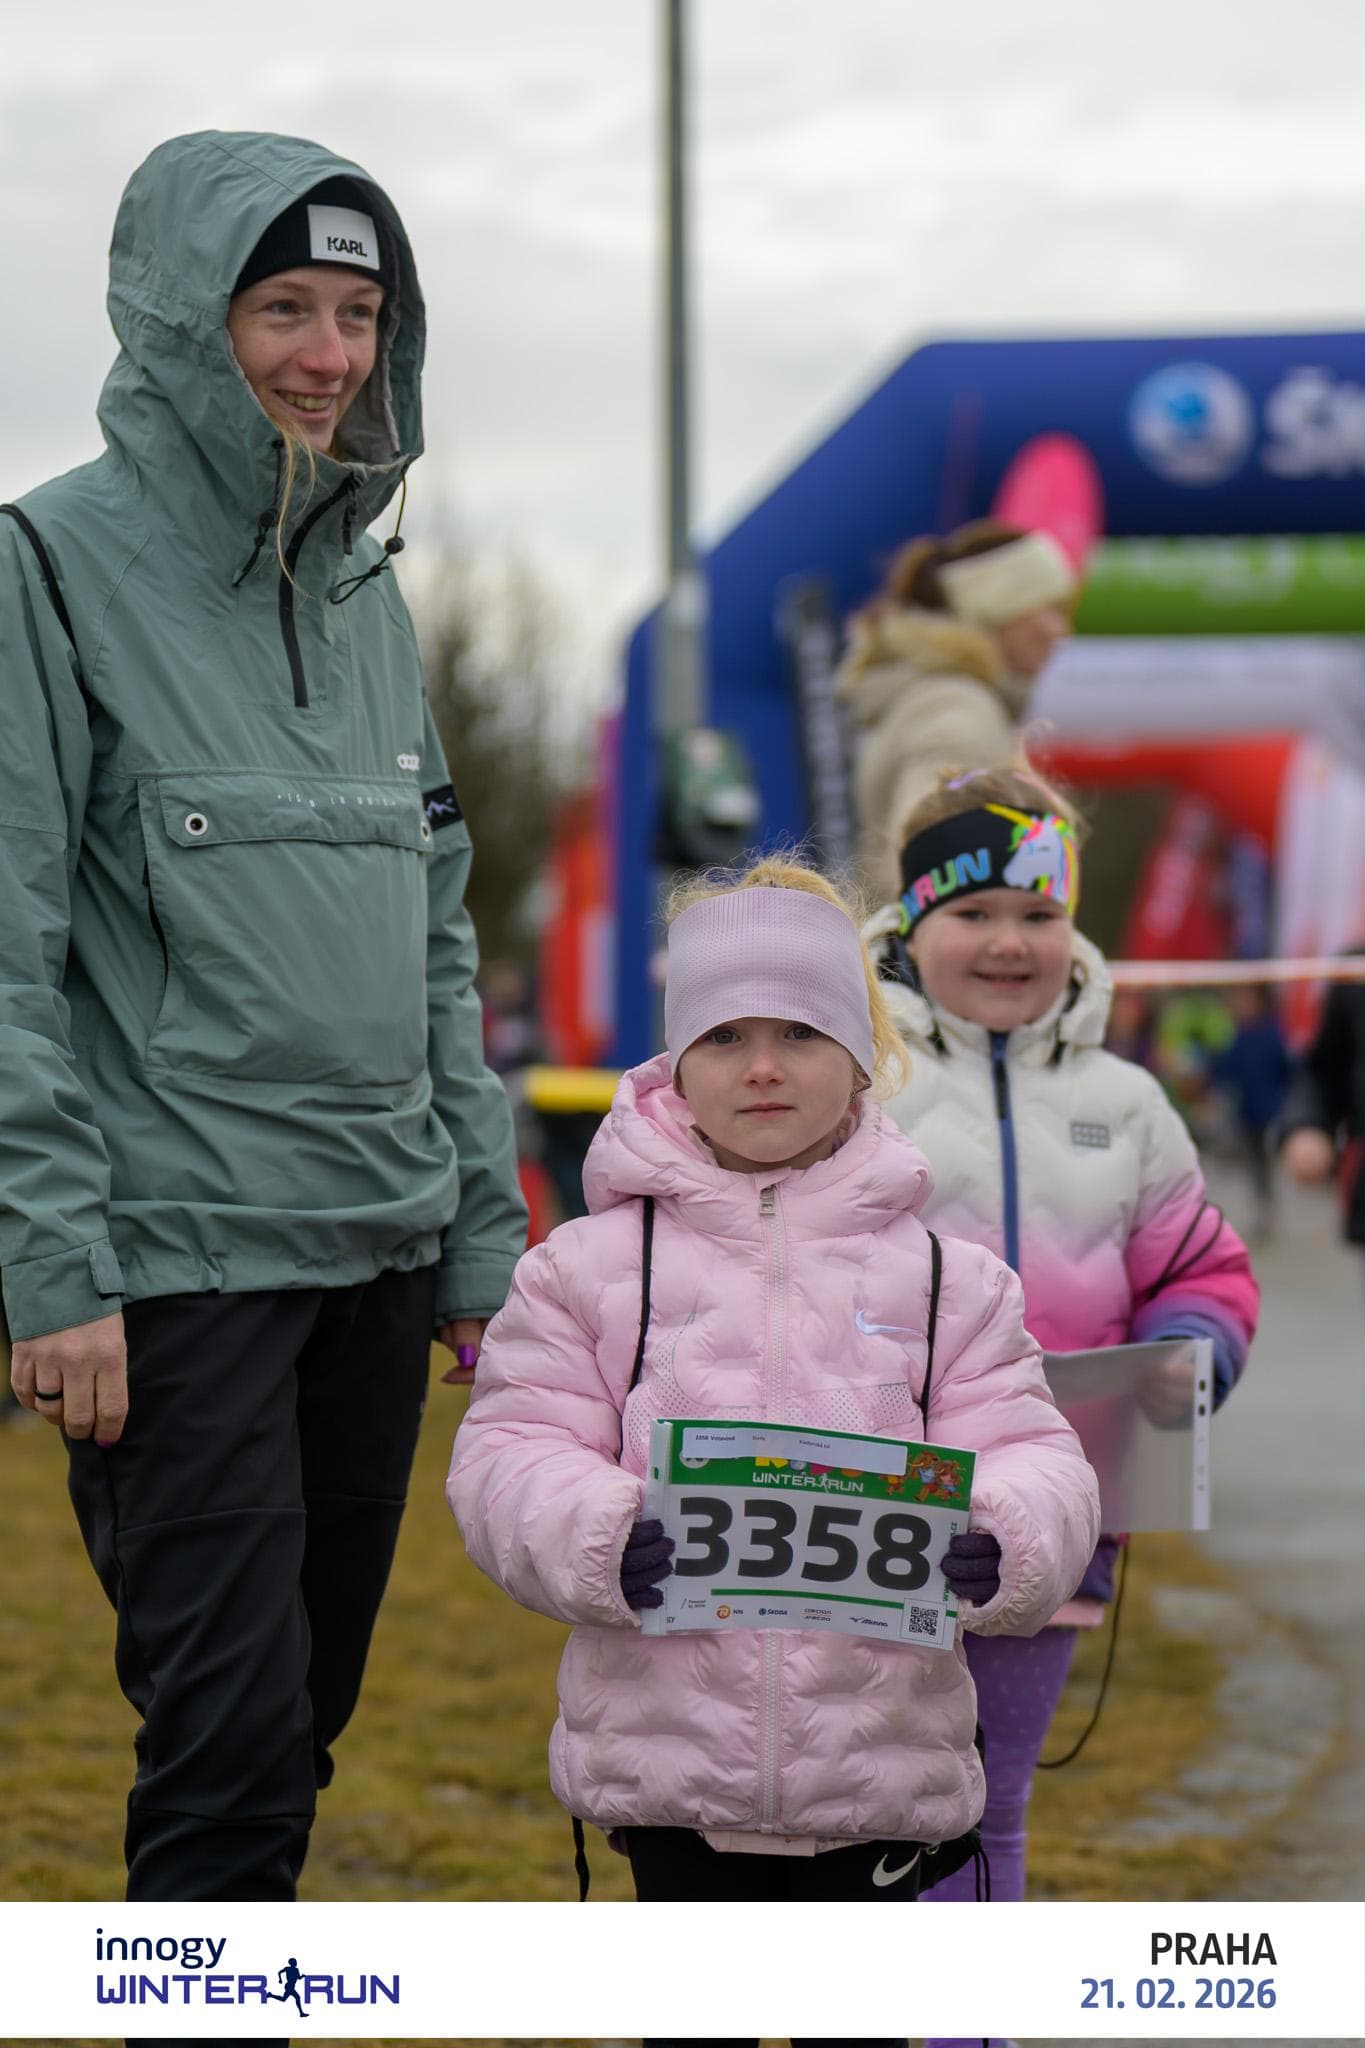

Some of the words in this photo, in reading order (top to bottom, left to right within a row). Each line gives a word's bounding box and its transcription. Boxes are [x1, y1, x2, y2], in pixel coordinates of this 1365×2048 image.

[327, 236, 368, 257] KARL
[752, 1472, 816, 1488] WINTER
[827, 1478, 864, 1493] RUN
[675, 1496, 932, 1592] 3358
